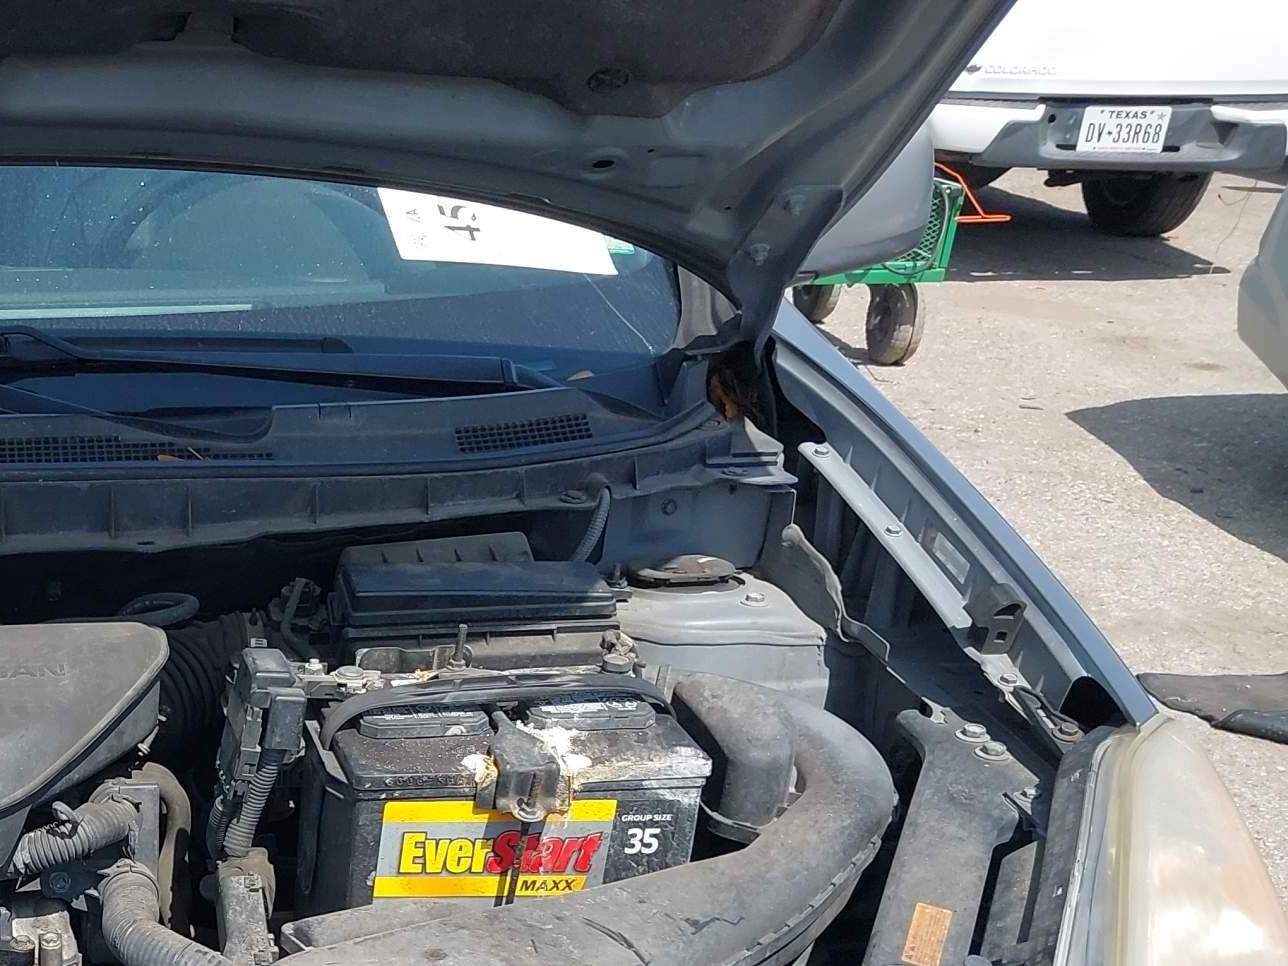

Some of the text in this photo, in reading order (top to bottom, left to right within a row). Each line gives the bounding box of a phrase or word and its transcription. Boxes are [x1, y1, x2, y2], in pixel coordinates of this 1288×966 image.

[1108, 110, 1148, 119] TEXAS
[621, 814, 672, 823] GROUP SIZE
[624, 828, 661, 854] 35
[519, 879, 577, 892] MAXX
